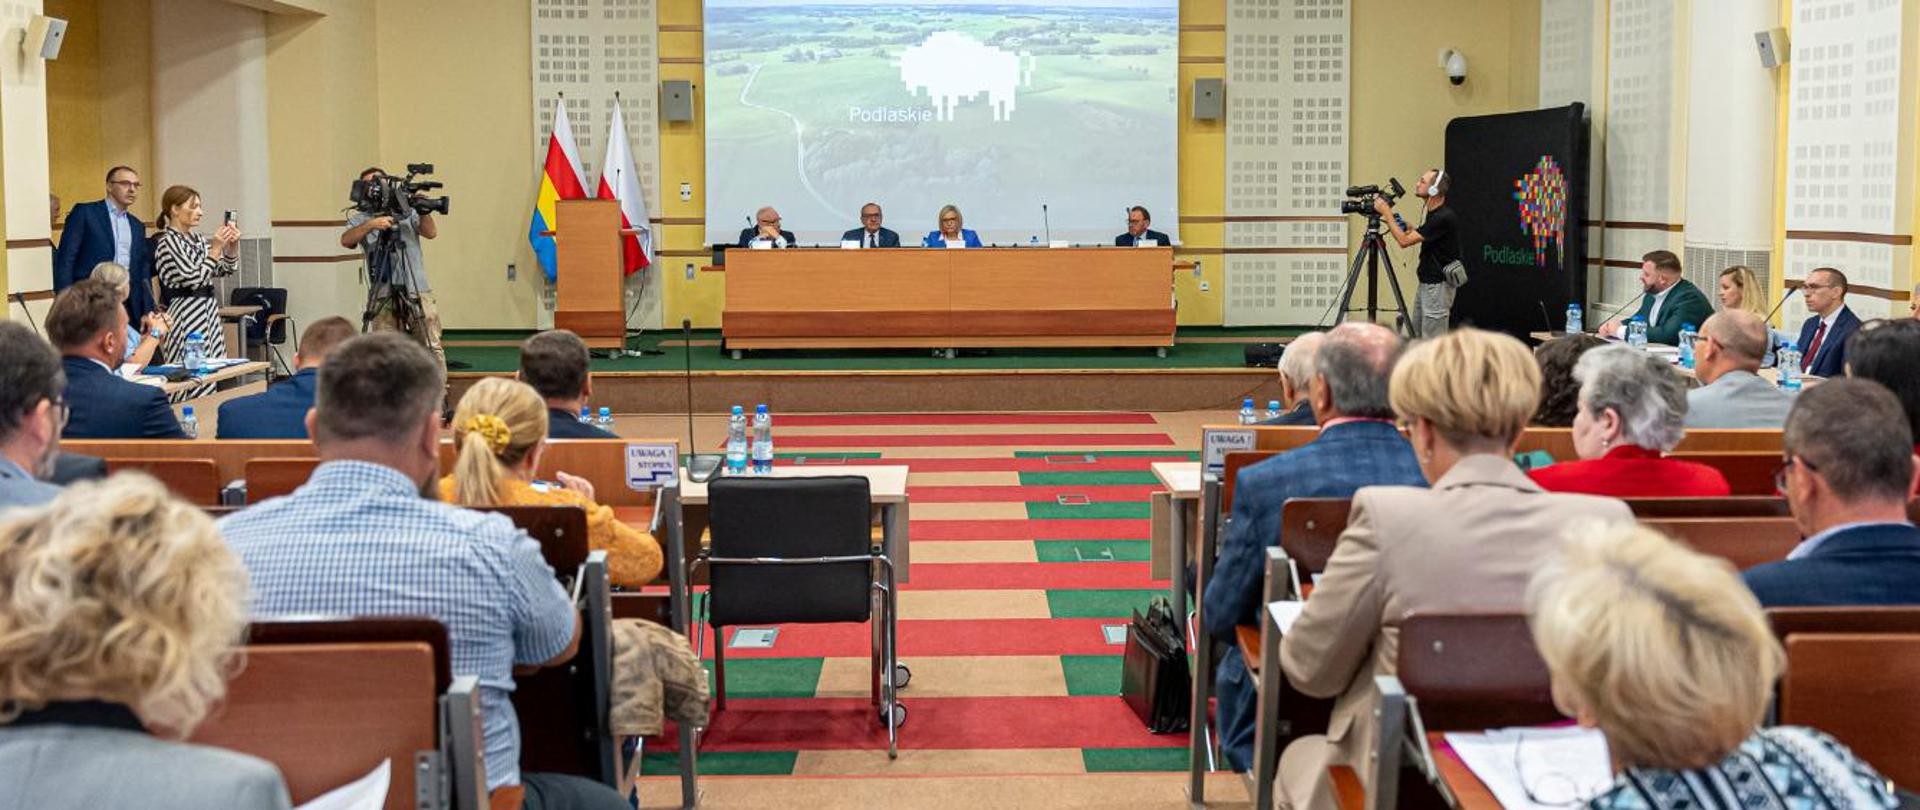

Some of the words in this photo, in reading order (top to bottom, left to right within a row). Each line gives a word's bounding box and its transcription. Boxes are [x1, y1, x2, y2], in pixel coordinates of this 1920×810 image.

[850, 106, 932, 122] Podlaskie
[1483, 244, 1535, 266] Podlaskie
[1210, 434, 1246, 444] UWAGA
[631, 449, 667, 458] UWAGA
